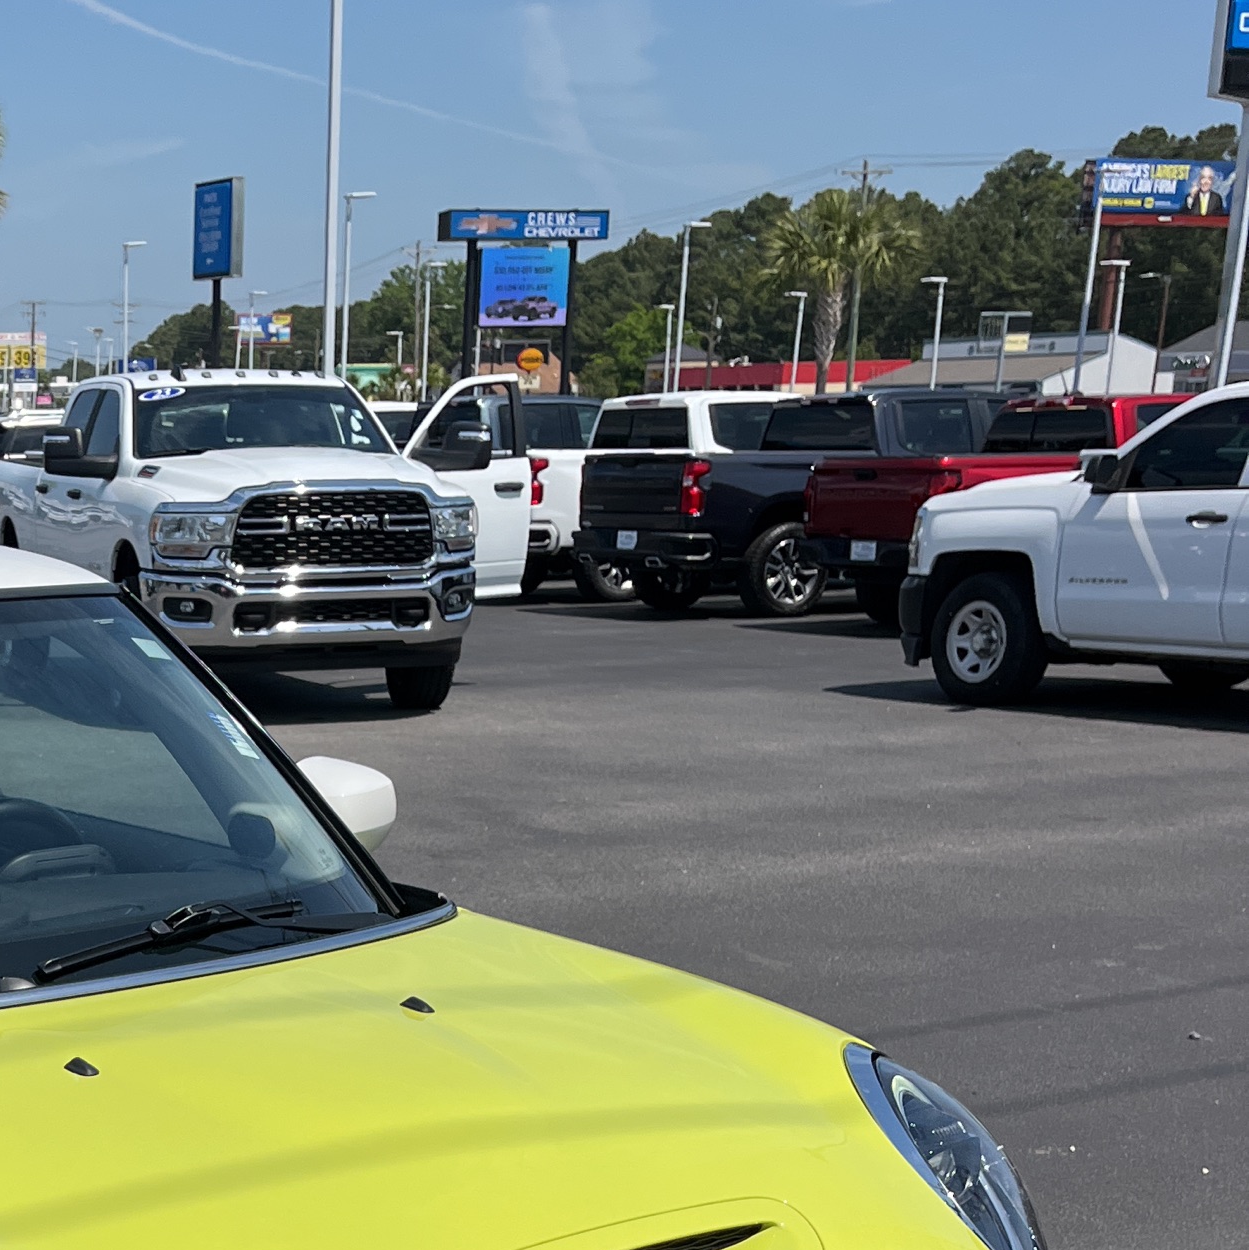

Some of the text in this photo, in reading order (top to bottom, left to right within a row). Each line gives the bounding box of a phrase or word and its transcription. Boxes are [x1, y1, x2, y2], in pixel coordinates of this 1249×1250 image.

[527, 211, 576, 226] CREWS
[524, 226, 600, 238] CHEVROLET
[295, 515, 379, 531] RAM
